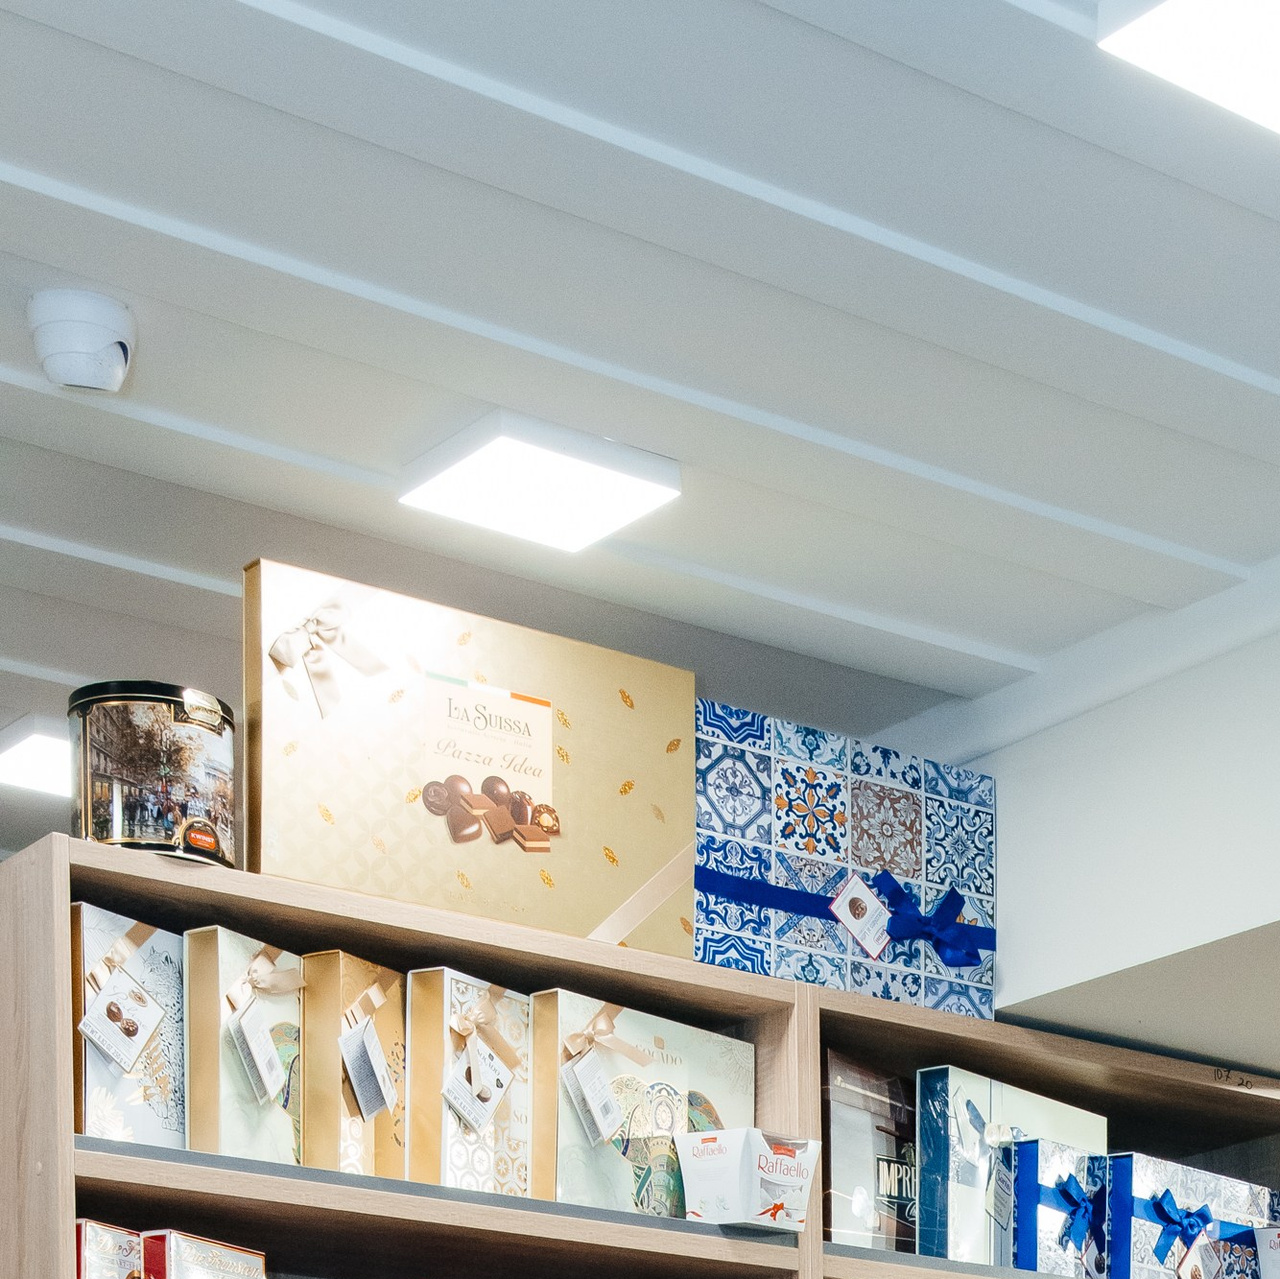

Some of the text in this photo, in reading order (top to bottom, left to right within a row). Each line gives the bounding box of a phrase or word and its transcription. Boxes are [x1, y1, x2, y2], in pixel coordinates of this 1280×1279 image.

[473, 704, 532, 738] SUISSA
[1238, 1077, 1253, 1090] 20
[692, 1144, 728, 1159] Raffaello
[757, 1154, 809, 1180] Raffaello
